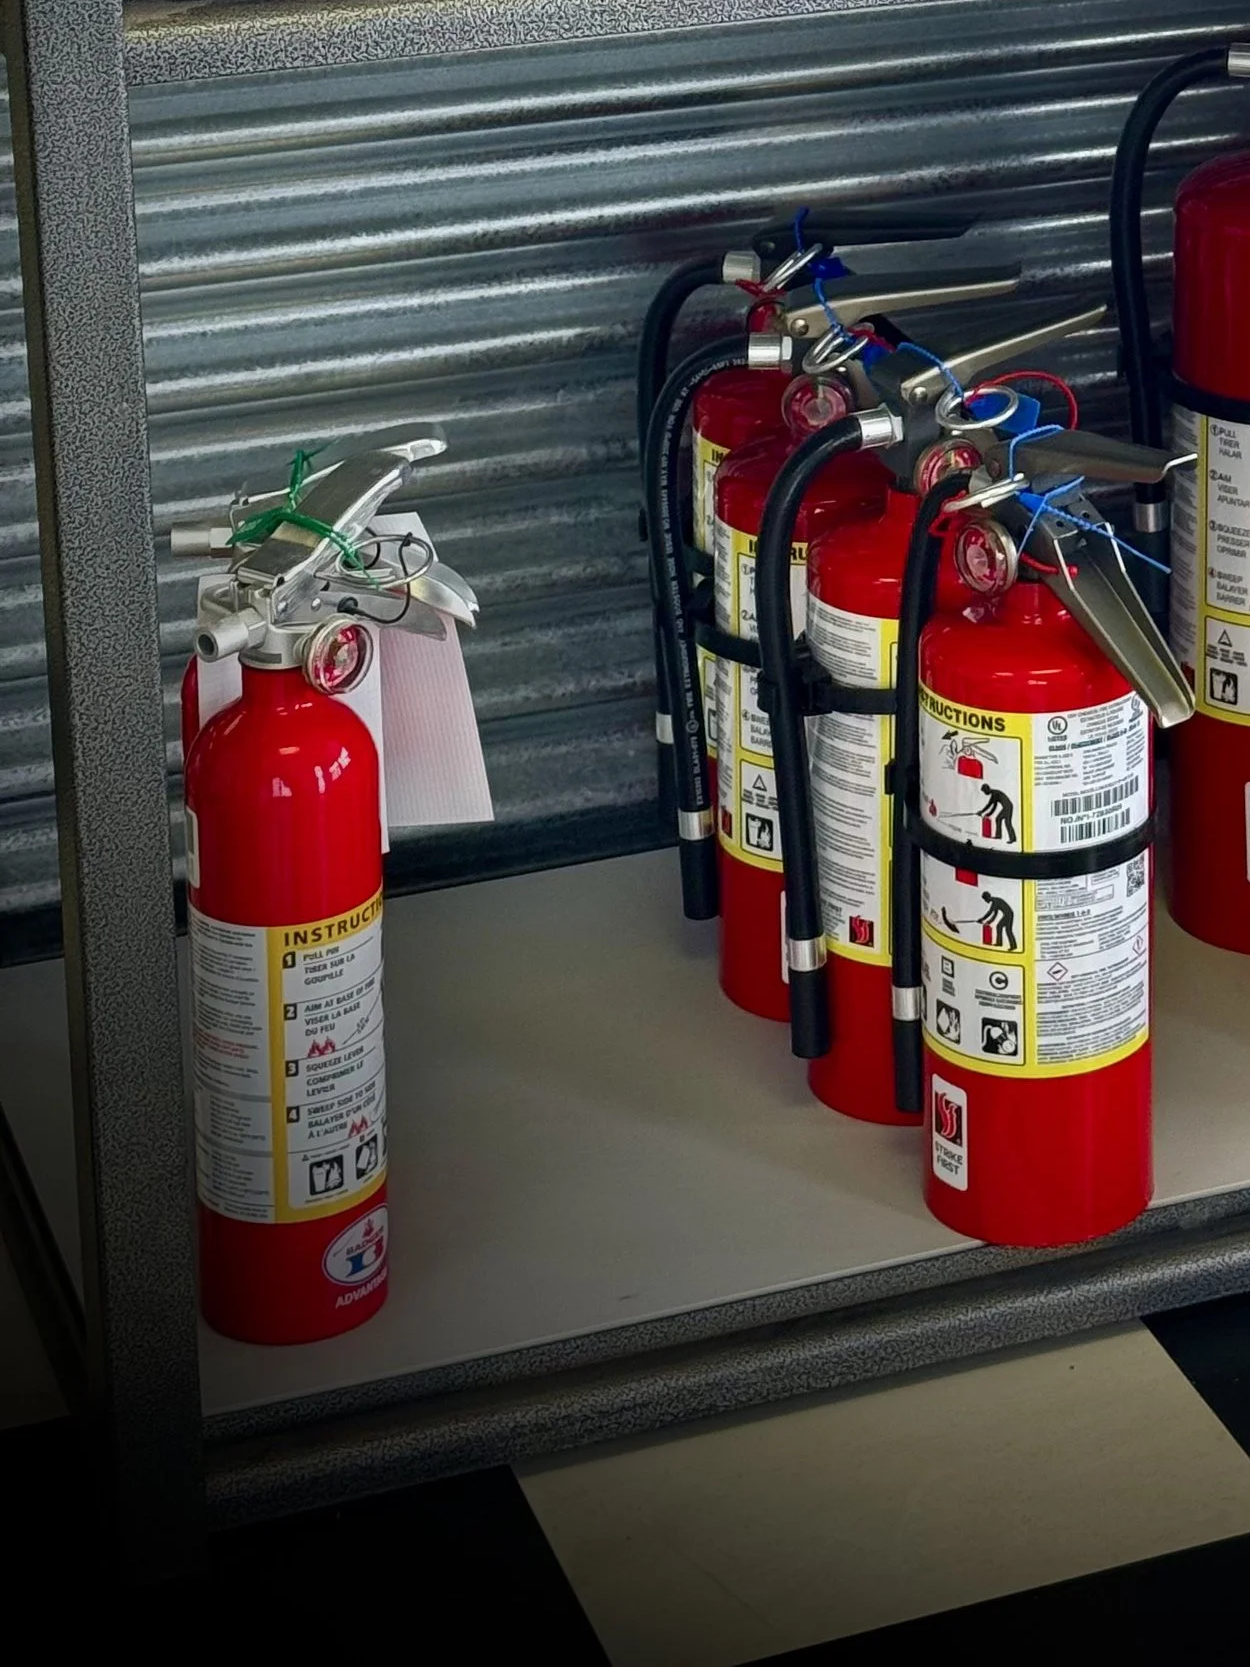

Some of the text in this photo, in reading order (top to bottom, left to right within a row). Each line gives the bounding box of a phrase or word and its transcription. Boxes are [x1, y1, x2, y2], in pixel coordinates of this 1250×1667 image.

[1219, 427, 1236, 438] PULL
[305, 1015, 329, 1026] VISER
[331, 1009, 341, 1018] LA
[320, 1023, 336, 1034] FEU
